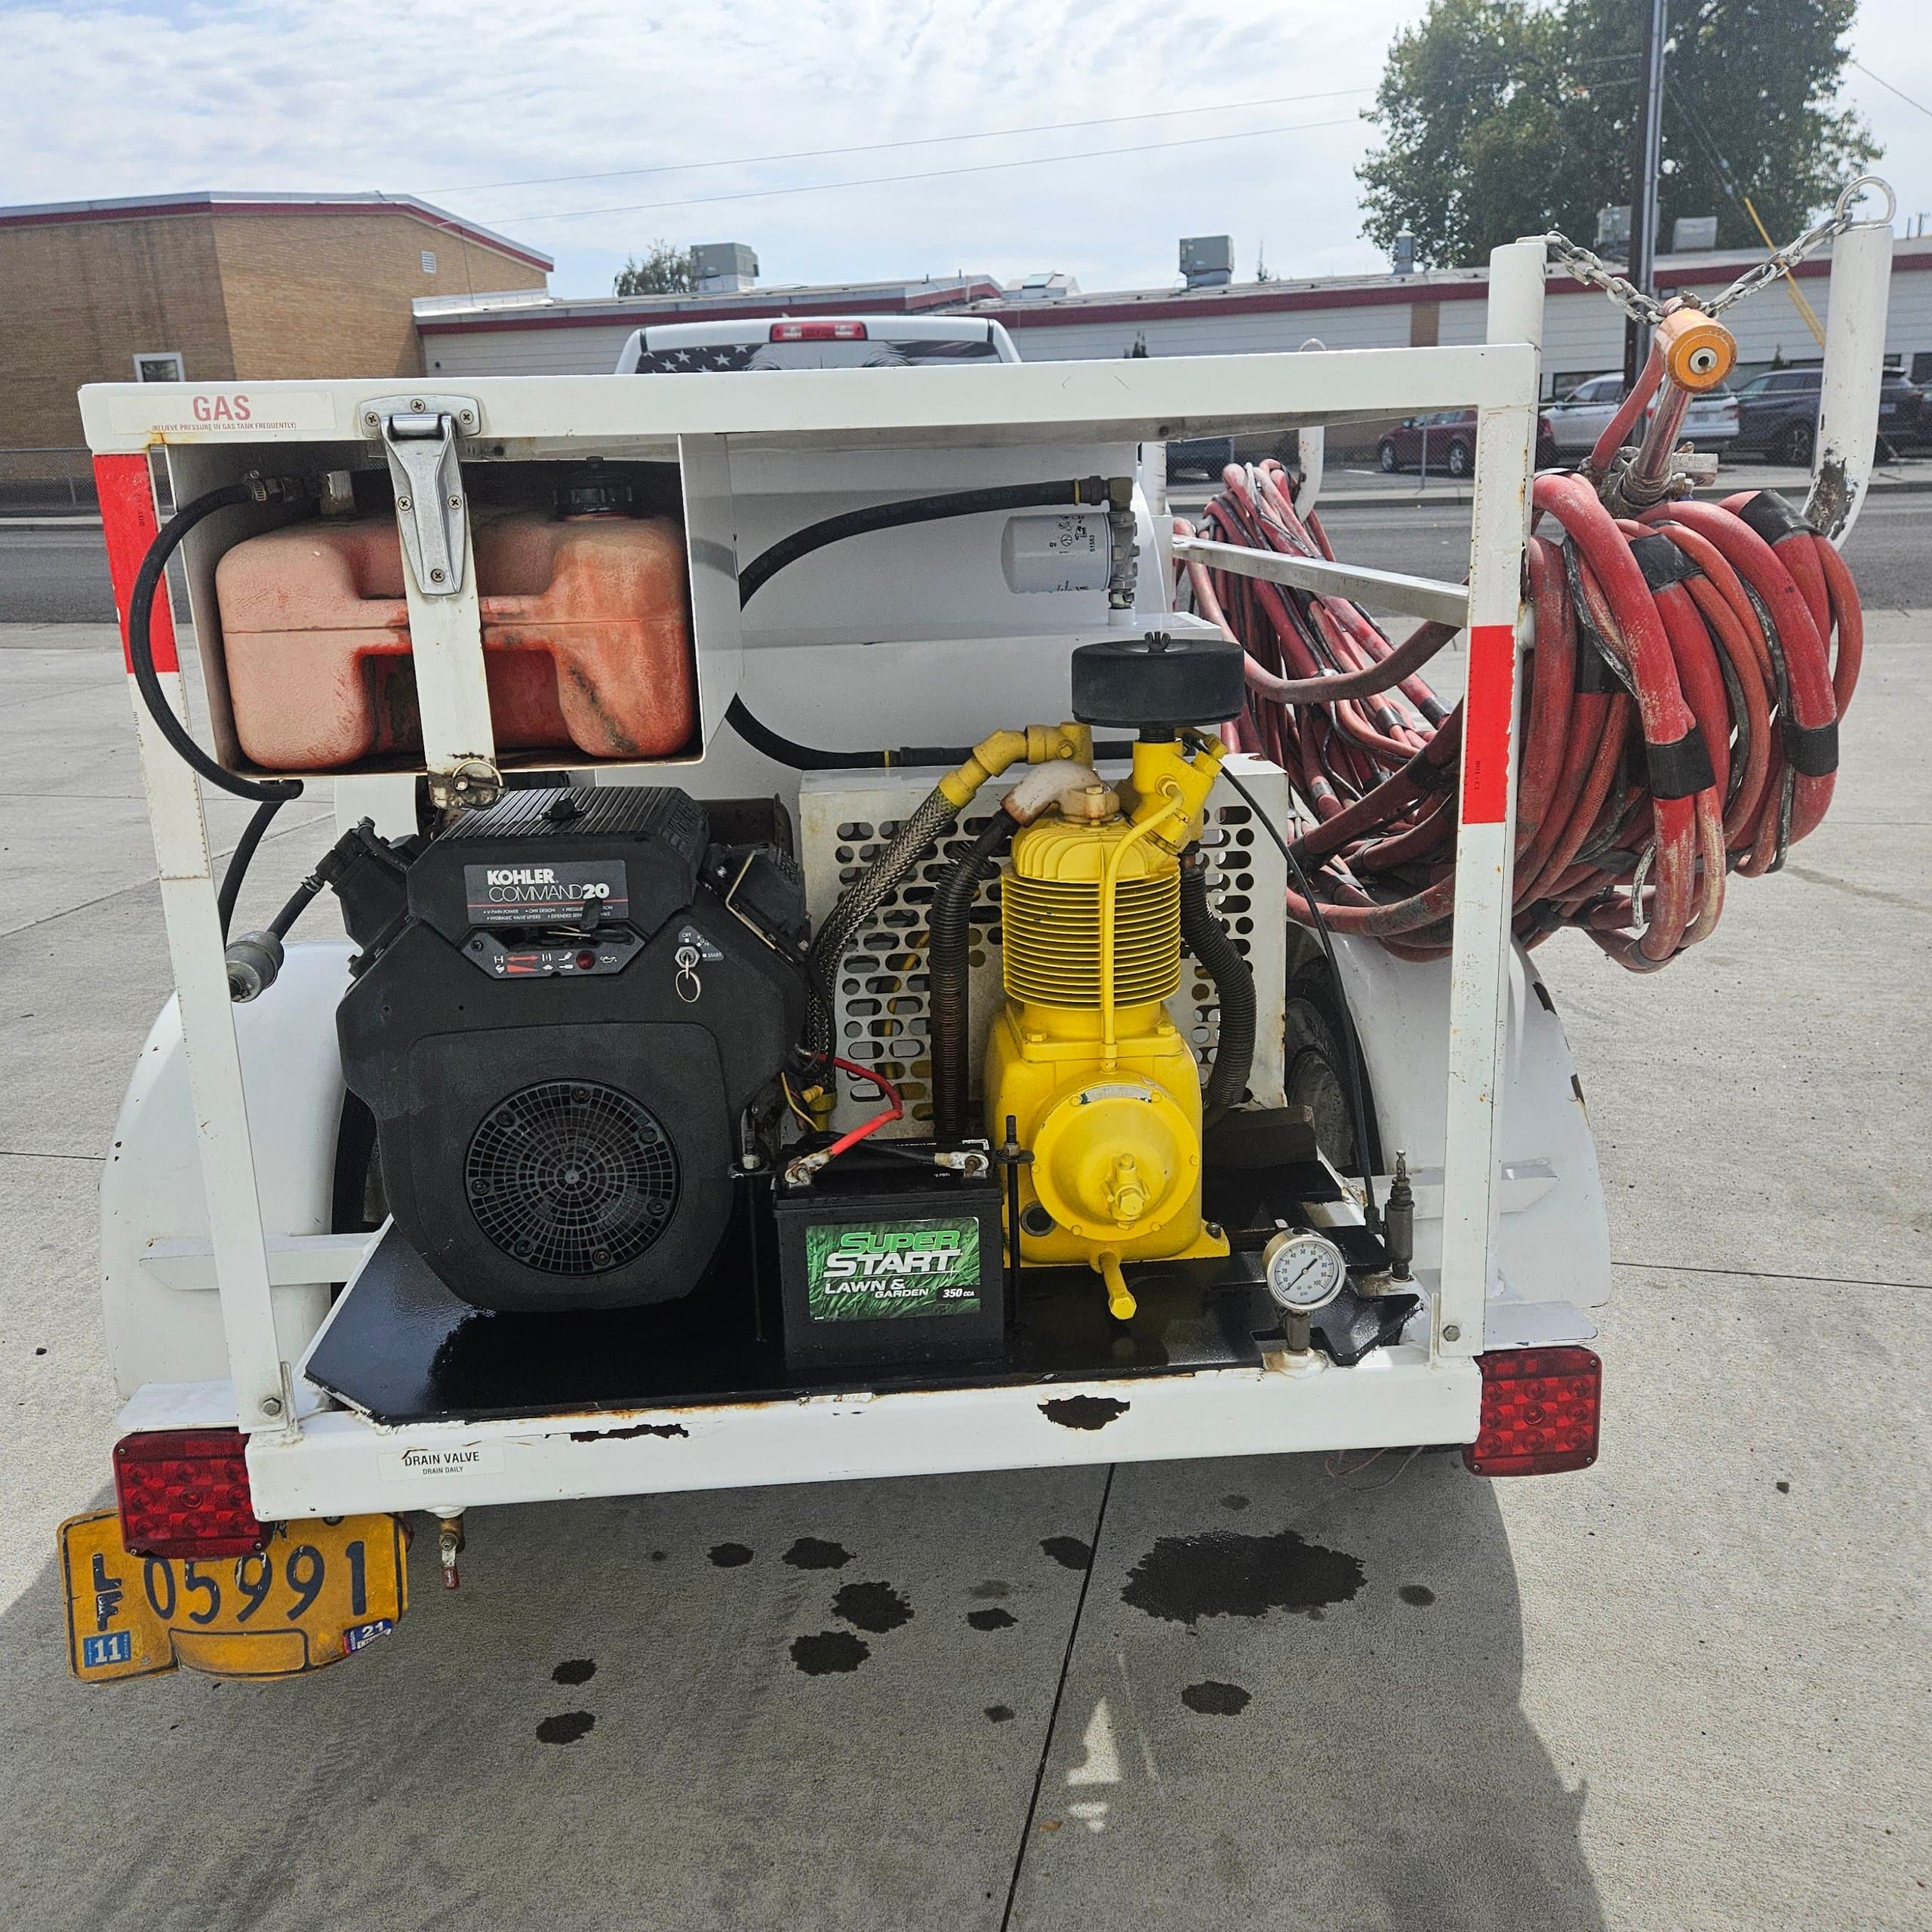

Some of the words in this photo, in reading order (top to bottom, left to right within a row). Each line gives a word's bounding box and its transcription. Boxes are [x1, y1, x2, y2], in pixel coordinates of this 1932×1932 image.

[192, 395, 251, 421] GAS
[487, 868, 556, 885] KOHLER
[839, 1229, 961, 1255] SUPER
[823, 1248, 962, 1278] START
[824, 1280, 886, 1295] LAWN
[890, 1278, 906, 1290] &
[874, 1288, 929, 1299] GARDEN
[943, 1288, 963, 1299] 350
[405, 1454, 440, 1467] DRAIN
[444, 1451, 480, 1464] VALVE
[423, 1467, 443, 1475] DRAIN
[445, 1466, 464, 1474] DAILY
[143, 1540, 368, 1624] 05991
[94, 1636, 122, 1663] 11
